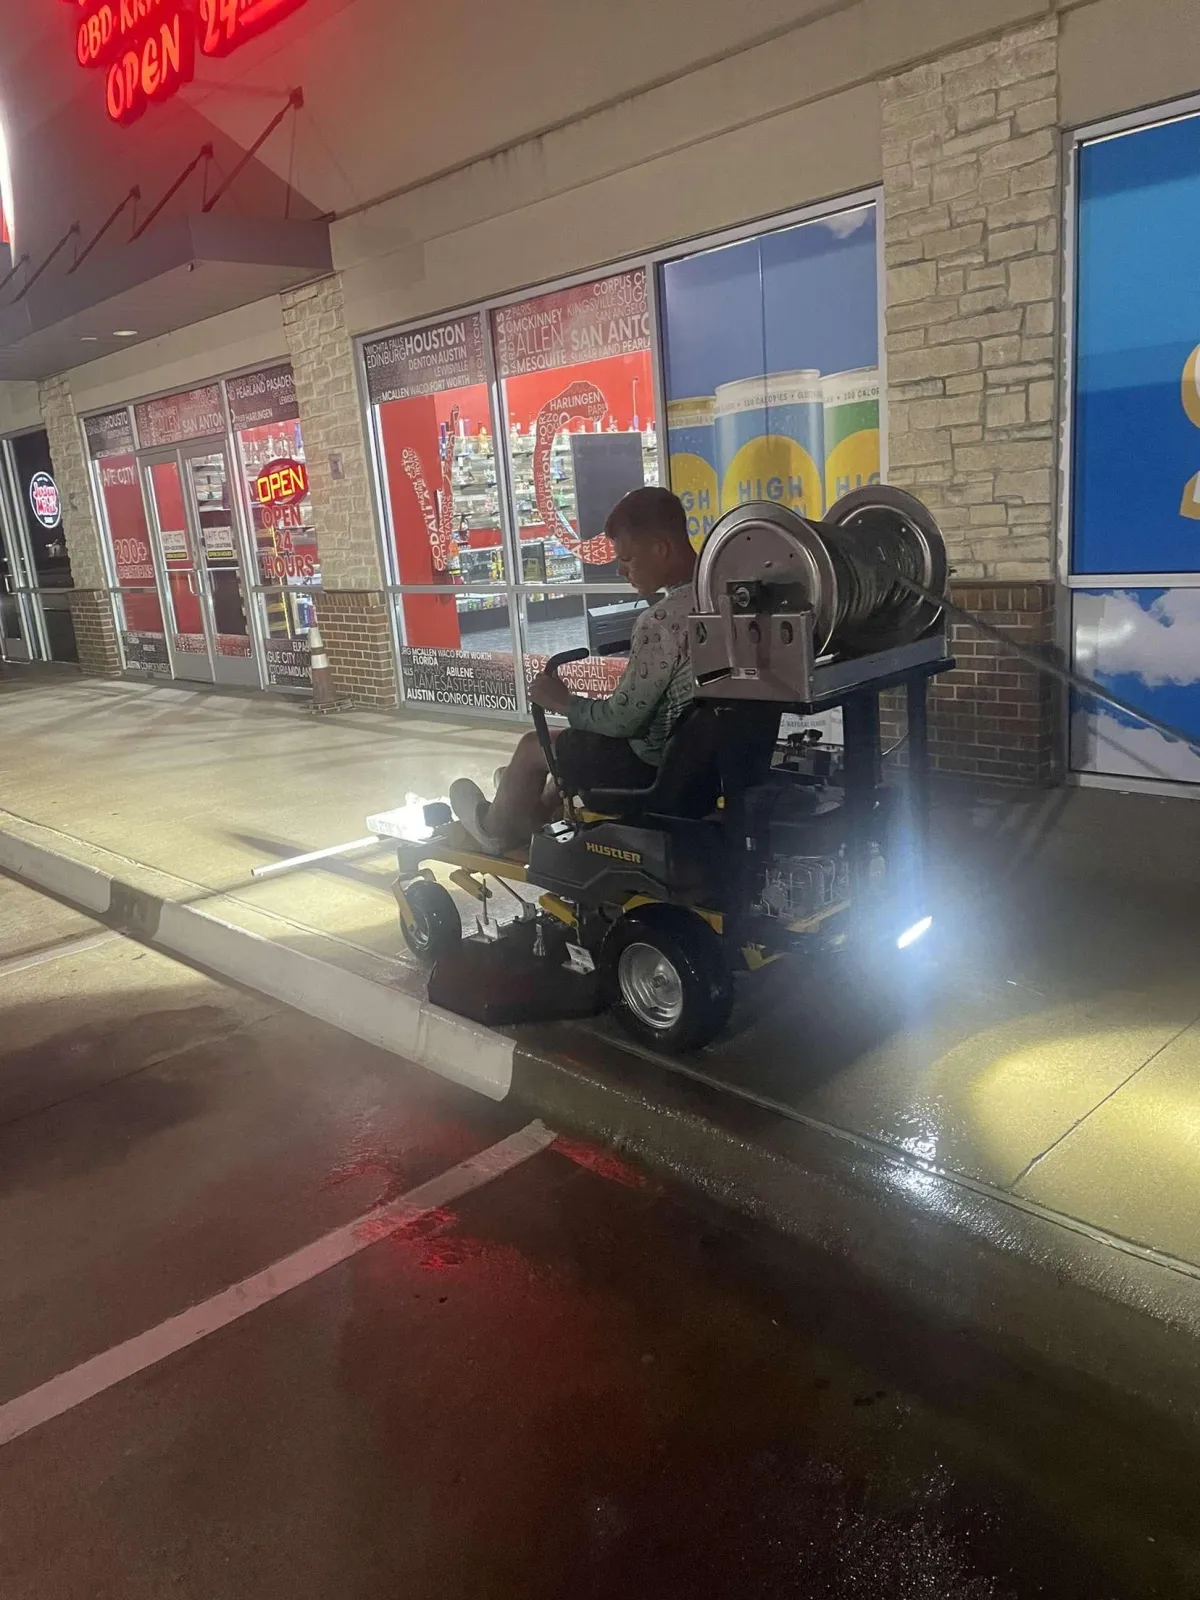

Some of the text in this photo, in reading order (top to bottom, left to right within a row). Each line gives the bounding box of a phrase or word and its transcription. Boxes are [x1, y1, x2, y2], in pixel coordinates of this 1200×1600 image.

[77, 5, 112, 65] CBD
[107, 13, 180, 119] OPEN
[593, 275, 631, 296] CORPUS
[567, 294, 616, 317] KINGSVILLE
[513, 308, 563, 333] MCKINNEY
[404, 322, 466, 356] HOUSTON
[496, 312, 509, 375] DALLAS
[516, 322, 565, 357] ALLEN
[571, 323, 604, 350] SAN
[366, 347, 407, 369] EDINBURG
[408, 345, 468, 371] DENTON AUSTIN
[516, 349, 568, 374] MESQUITE
[381, 388, 410, 401] MCALLEN
[429, 379, 446, 392] FORT
[446, 374, 470, 389] WORTH
[550, 392, 600, 411] HARLINGEN
[182, 416, 198, 433] SAN
[257, 465, 305, 503] OPEN
[541, 450, 556, 522] HOUSTON
[738, 475, 803, 500] HIGH
[679, 488, 710, 511] GH
[262, 503, 303, 529] OPEN
[275, 529, 294, 554] 24
[263, 554, 315, 579] HOURS
[281, 651, 295, 664] CITY
[411, 647, 437, 657] MCALLEN
[437, 649, 455, 658] WACO
[455, 650, 470, 659] FORT
[471, 651, 492, 660] WORTH
[412, 655, 439, 666] FLORIDA
[446, 666, 475, 679] ABILENE
[475, 669, 514, 682] GRANBURY
[557, 664, 607, 680] MARSHALL
[562, 677, 608, 692] ONGVIEW
[413, 673, 454, 692] LAMESA
[453, 678, 515, 697] STEPHENVILLE
[406, 687, 516, 711] AUSTIN CONROE MISSION
[585, 841, 642, 864] HUSTLER
